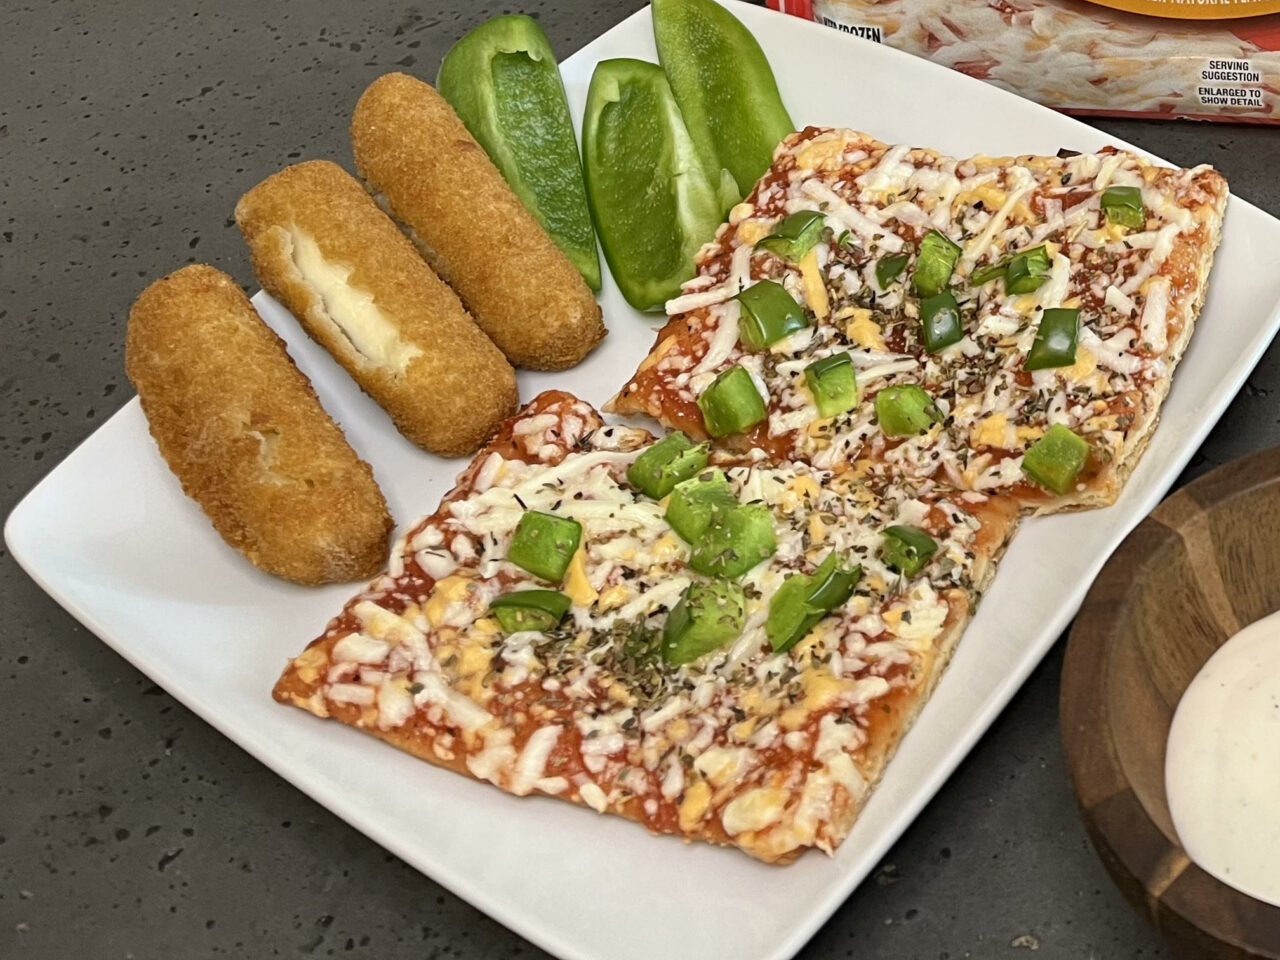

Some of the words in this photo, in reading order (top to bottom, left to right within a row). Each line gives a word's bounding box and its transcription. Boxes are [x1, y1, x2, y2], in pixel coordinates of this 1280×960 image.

[1209, 60, 1249, 71] SERVING
[1202, 70, 1260, 82] SUGGESTION
[1198, 87, 1247, 98] ENLARGED
[1249, 89, 1261, 98] TO
[1201, 97, 1229, 105] SHOW
[1230, 97, 1263, 107] DETAIL
